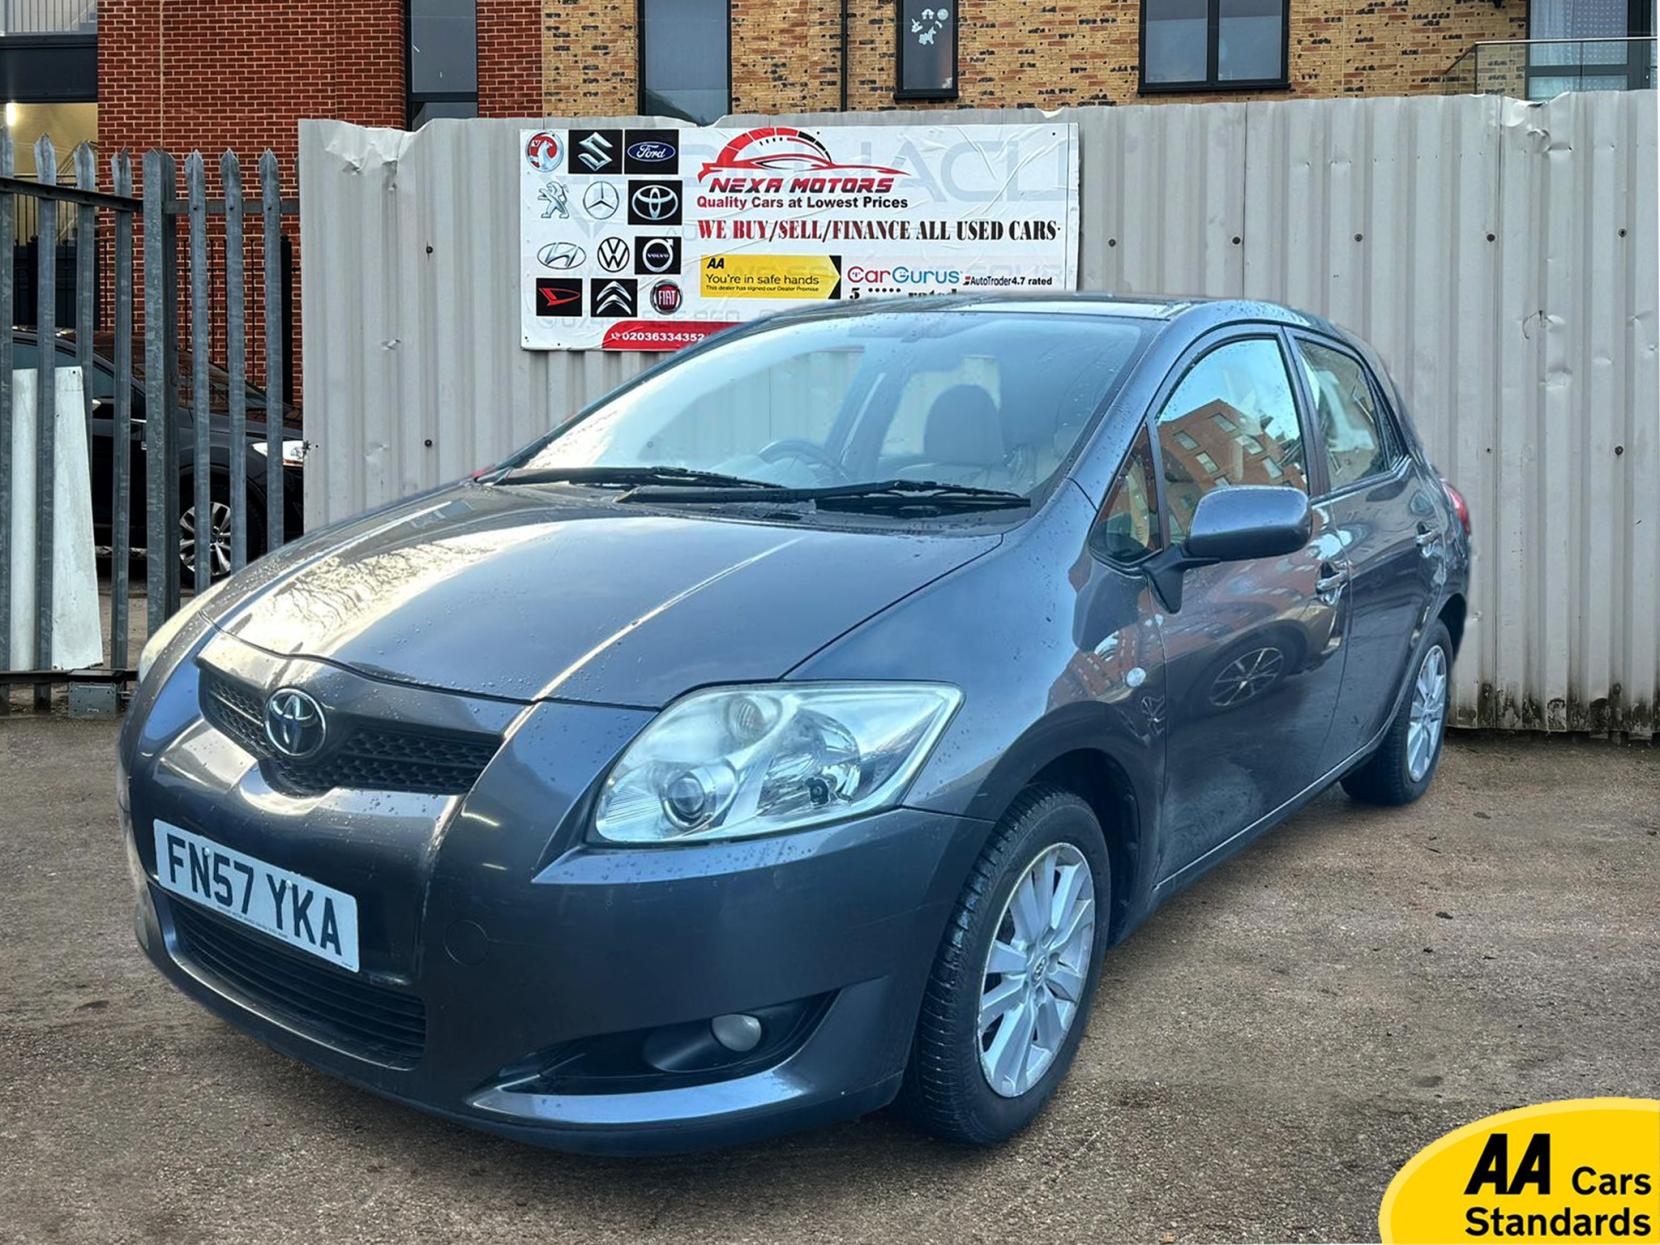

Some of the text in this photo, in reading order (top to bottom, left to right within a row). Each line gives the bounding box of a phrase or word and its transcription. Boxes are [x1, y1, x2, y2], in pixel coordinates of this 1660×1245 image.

[636, 144, 666, 158] Ford
[708, 177, 894, 194] NEXA MOTORS
[697, 195, 908, 211] Quality Cars at Lowest Prices
[697, 219, 727, 240] WE
[732, 219, 911, 243] BUY/SELL/FINANCE
[915, 220, 951, 240] ALL
[956, 220, 1003, 240] USED
[1008, 220, 1057, 241] CARS
[706, 257, 725, 269] AA
[705, 273, 820, 285] You're in safe hands
[847, 266, 960, 284] CarGurus
[1011, 277, 1026, 285] 4.7
[1027, 277, 1052, 285] rated
[658, 290, 676, 305] FIAT
[850, 287, 860, 299] 5
[622, 332, 704, 342] 02036334352
[167, 833, 342, 956] FN57 YKA
